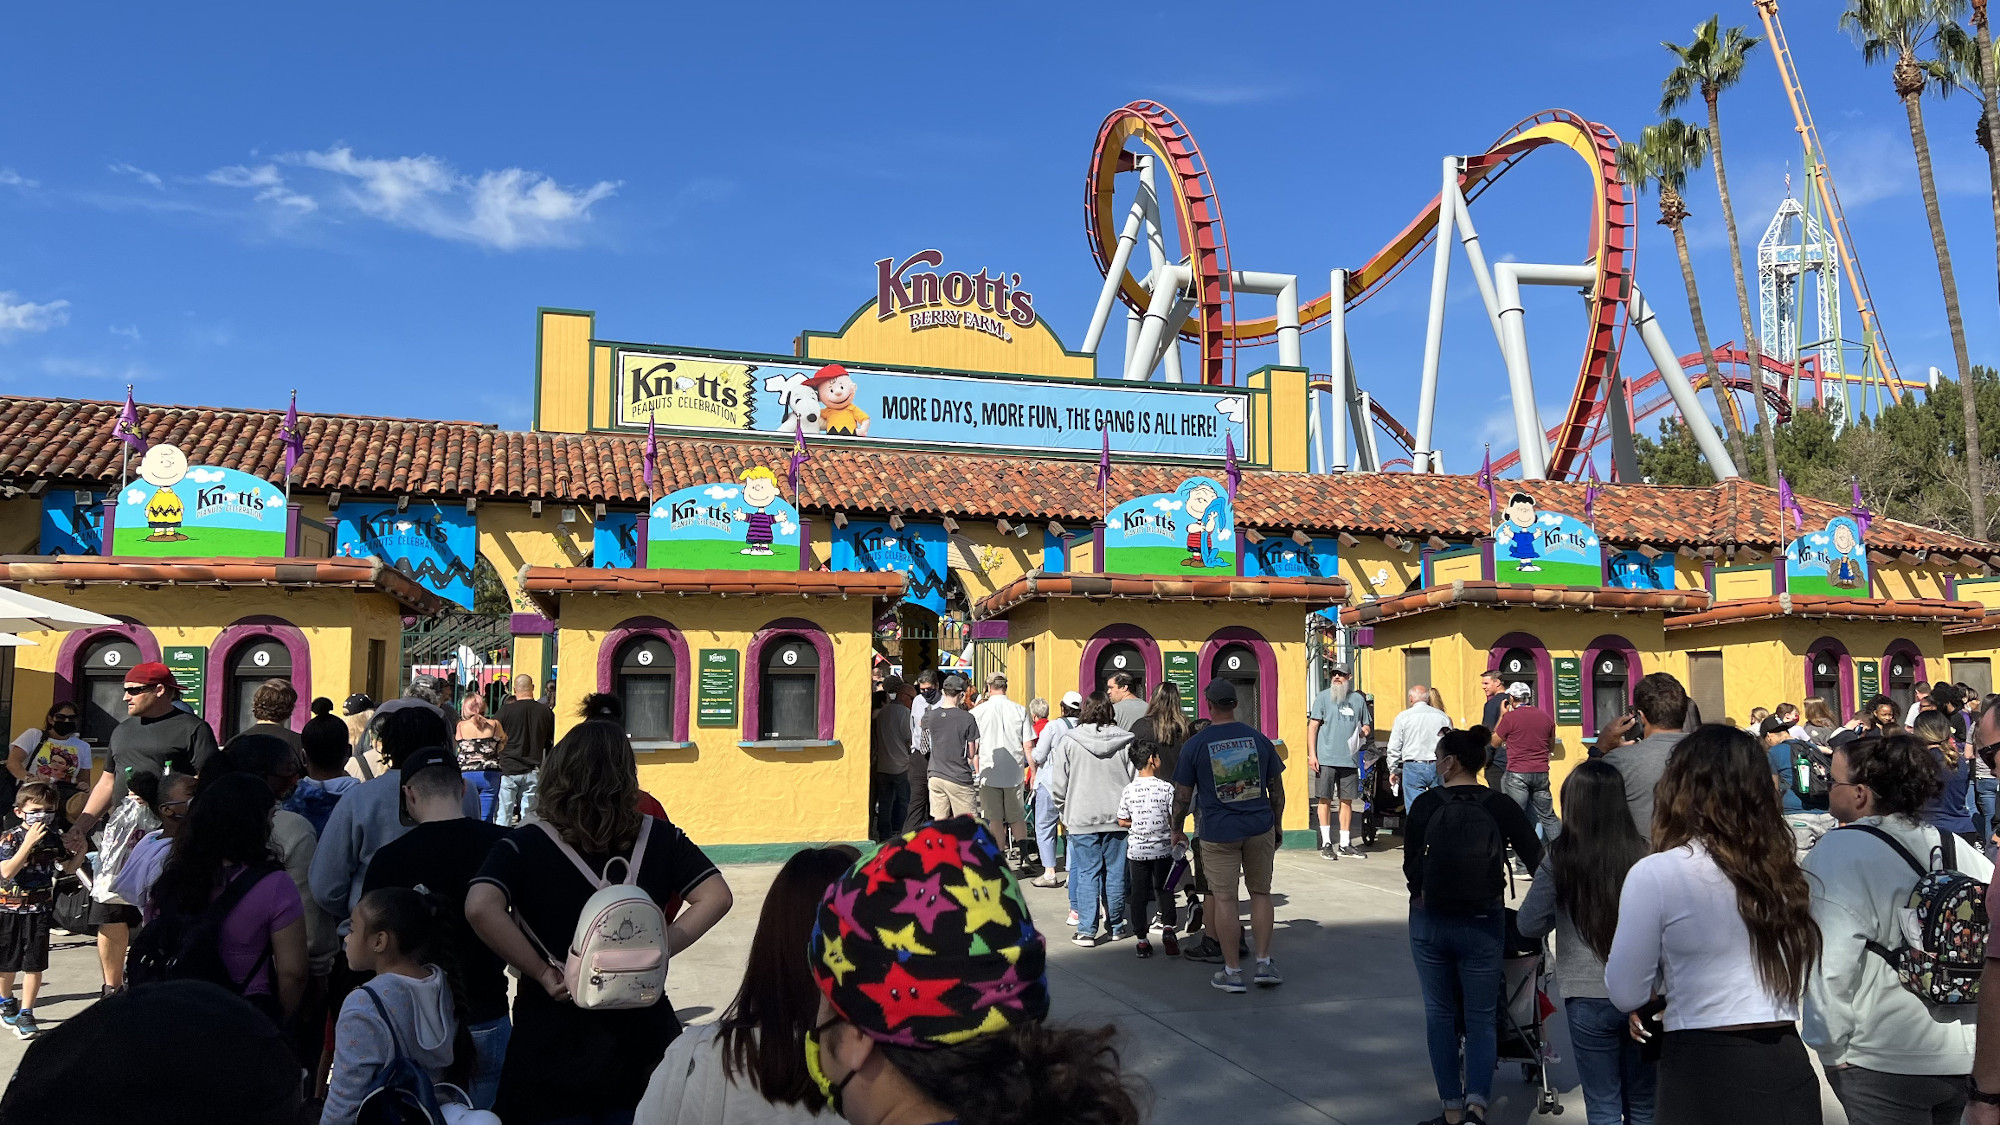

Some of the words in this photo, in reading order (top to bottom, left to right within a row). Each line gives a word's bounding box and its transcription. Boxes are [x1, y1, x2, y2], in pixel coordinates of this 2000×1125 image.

[875, 249, 1036, 326] Knott's
[909, 310, 960, 329] BERRY
[963, 311, 1005, 337] FARM
[632, 396, 673, 418] PEANUTS
[678, 396, 737, 425] CELEBRATION
[882, 395, 927, 421] MORE
[931, 398, 978, 428] DAYS,
[981, 402, 1025, 427] MORE
[1028, 404, 1063, 433] FUN,
[1066, 407, 1091, 431] THE
[1094, 409, 1135, 433] GANG
[1138, 411, 1150, 434] IS
[1154, 412, 1178, 435] ALL
[1181, 413, 1217, 438] HERE!
[360, 536, 393, 554] PEANUTS
[397, 536, 447, 556] CELEBRATION
[109, 653, 116, 663] 3
[257, 653, 265, 663] 4
[642, 653, 649, 662] 5
[787, 653, 794, 662] 6
[1210, 739, 1256, 754] YOSEMITE
